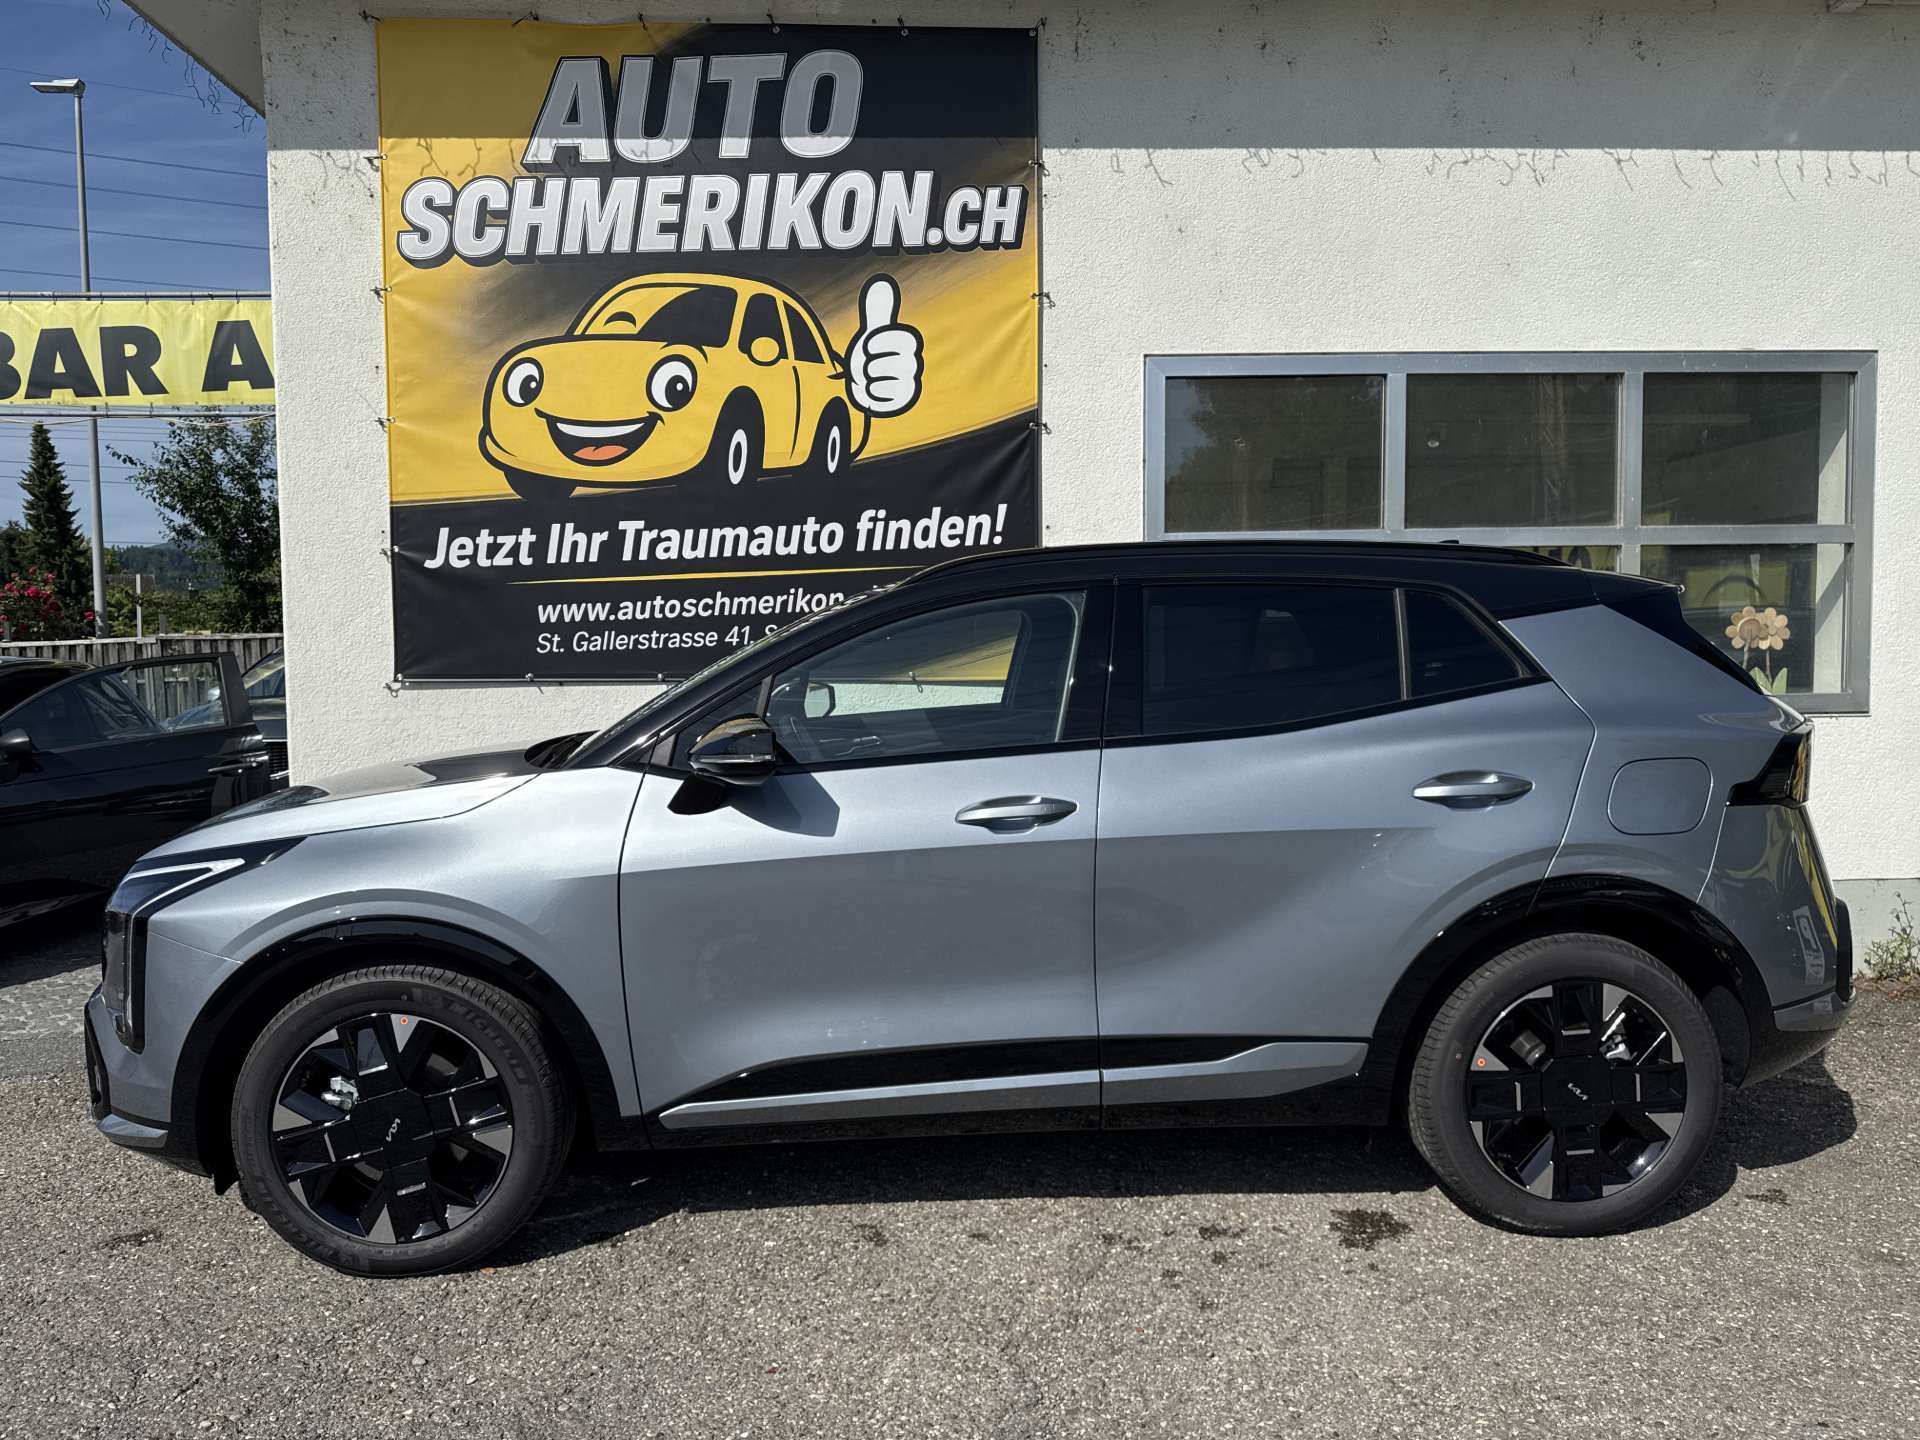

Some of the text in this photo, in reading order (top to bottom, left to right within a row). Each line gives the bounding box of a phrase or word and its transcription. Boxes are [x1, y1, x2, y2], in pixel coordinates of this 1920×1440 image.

[521, 49, 865, 164] AUTO
[398, 169, 1022, 259] SCHMERIKON.CH
[423, 503, 1008, 569] Jetzt Ihr Traumauto finden!
[536, 586, 878, 624] www.autoschmerikon
[536, 632, 566, 654] St.
[572, 626, 718, 653] Gallerstrasse
